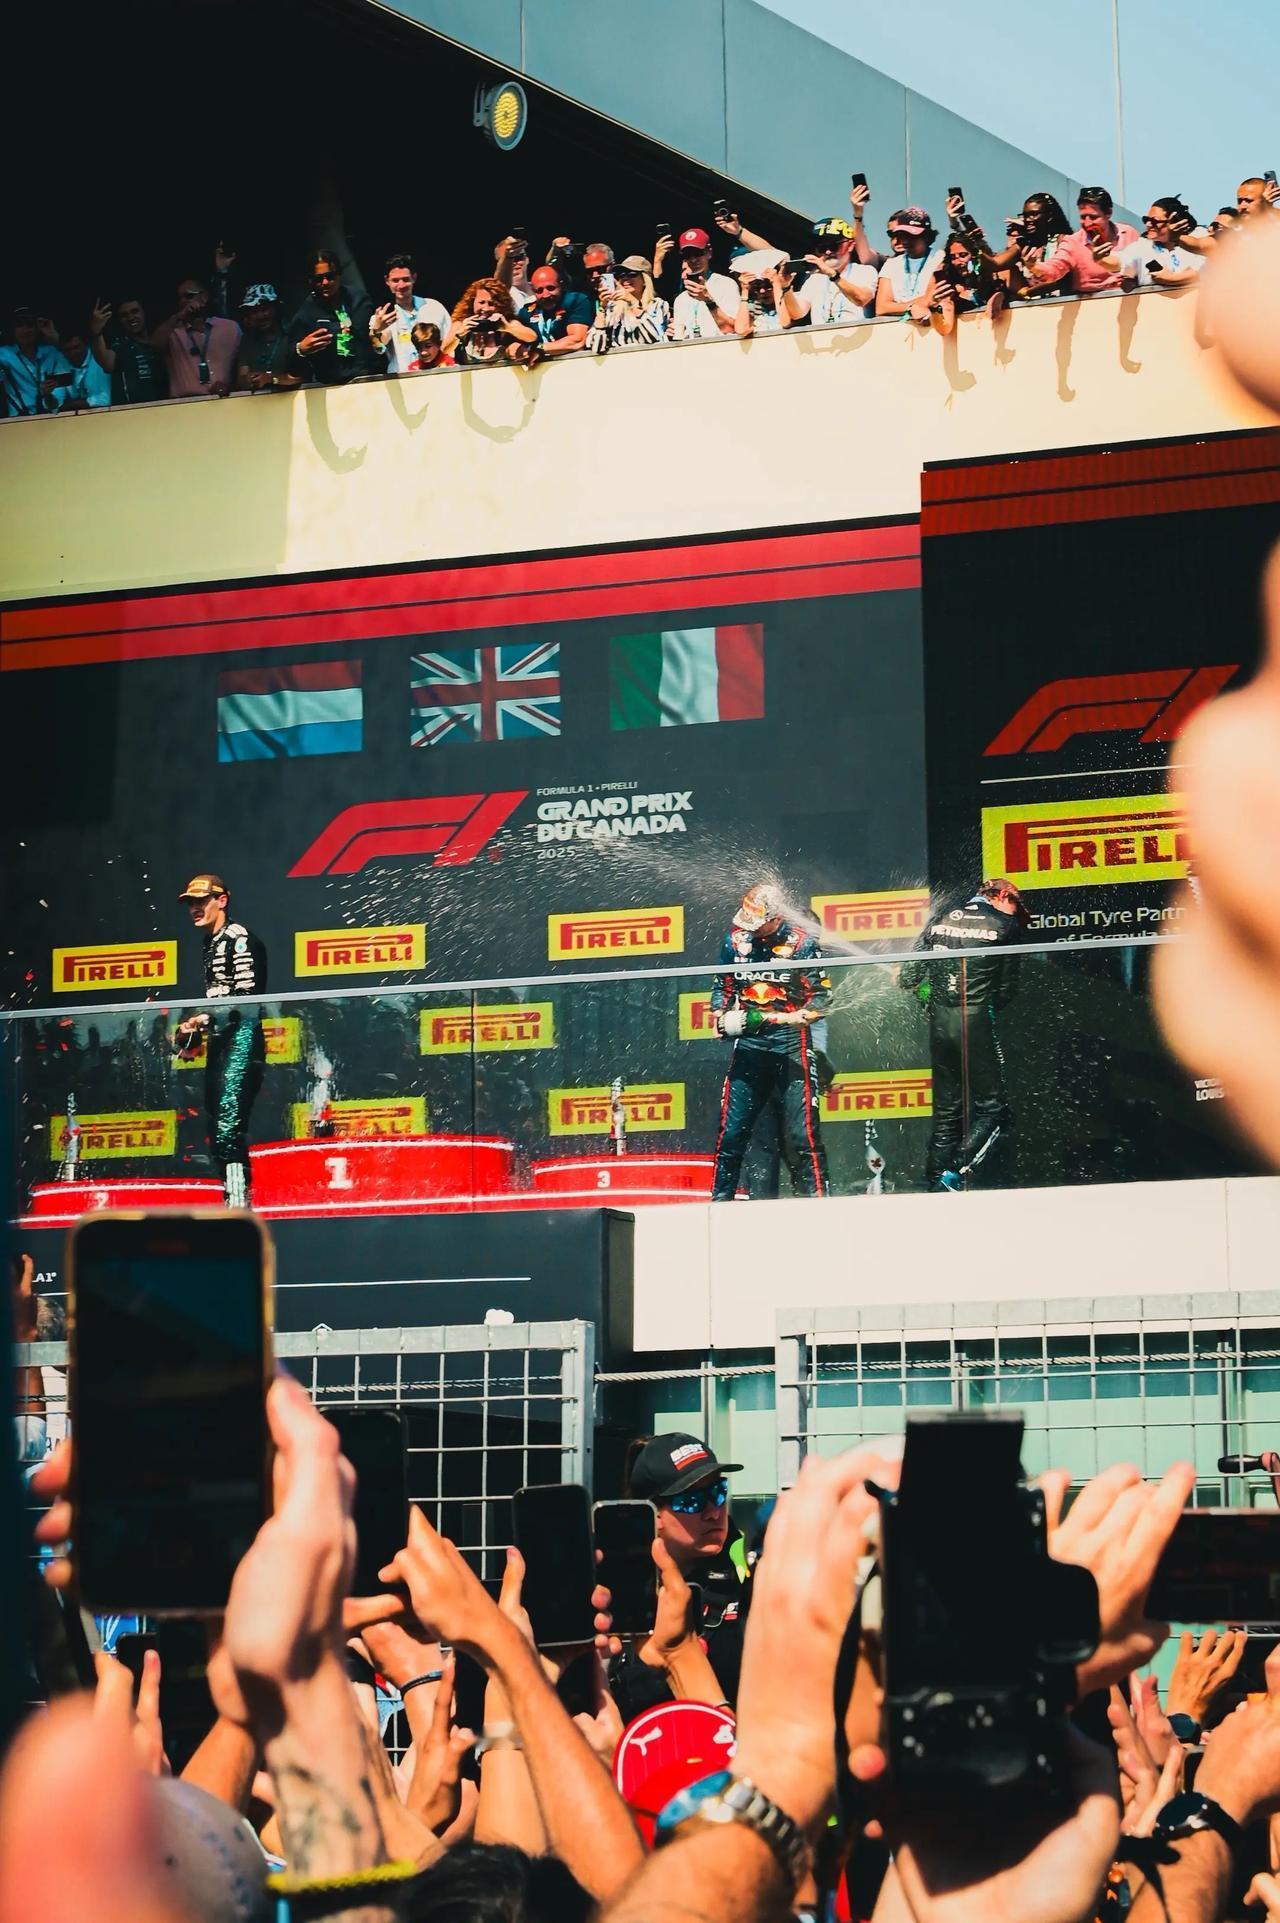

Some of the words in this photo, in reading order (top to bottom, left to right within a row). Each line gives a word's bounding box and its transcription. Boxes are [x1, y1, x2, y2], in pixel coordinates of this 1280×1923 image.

[537, 784, 585, 797] FORMULA
[587, 784, 593, 793] 1
[601, 781, 638, 791] PIRELLI
[537, 796, 629, 821] GRAND
[631, 790, 694, 814] PRIX
[537, 822, 572, 842] DU
[576, 813, 687, 840] CANADA
[1004, 810, 1198, 873] PIRELL
[537, 846, 575, 859] 2025
[560, 916, 671, 950] PIRELLI
[1089, 909, 1133, 927] Tyre
[307, 933, 413, 966] PIRELLI
[63, 950, 166, 983] PIRELLI
[734, 971, 791, 983] ORACLE
[432, 1012, 541, 1045] PIRELLI
[561, 1093, 672, 1125] PIRLLI
[826, 1078, 932, 1111] PIRELL
[324, 1156, 353, 1190] 1
[597, 1170, 611, 1188] 3
[670, 1443, 704, 1463] BEST
